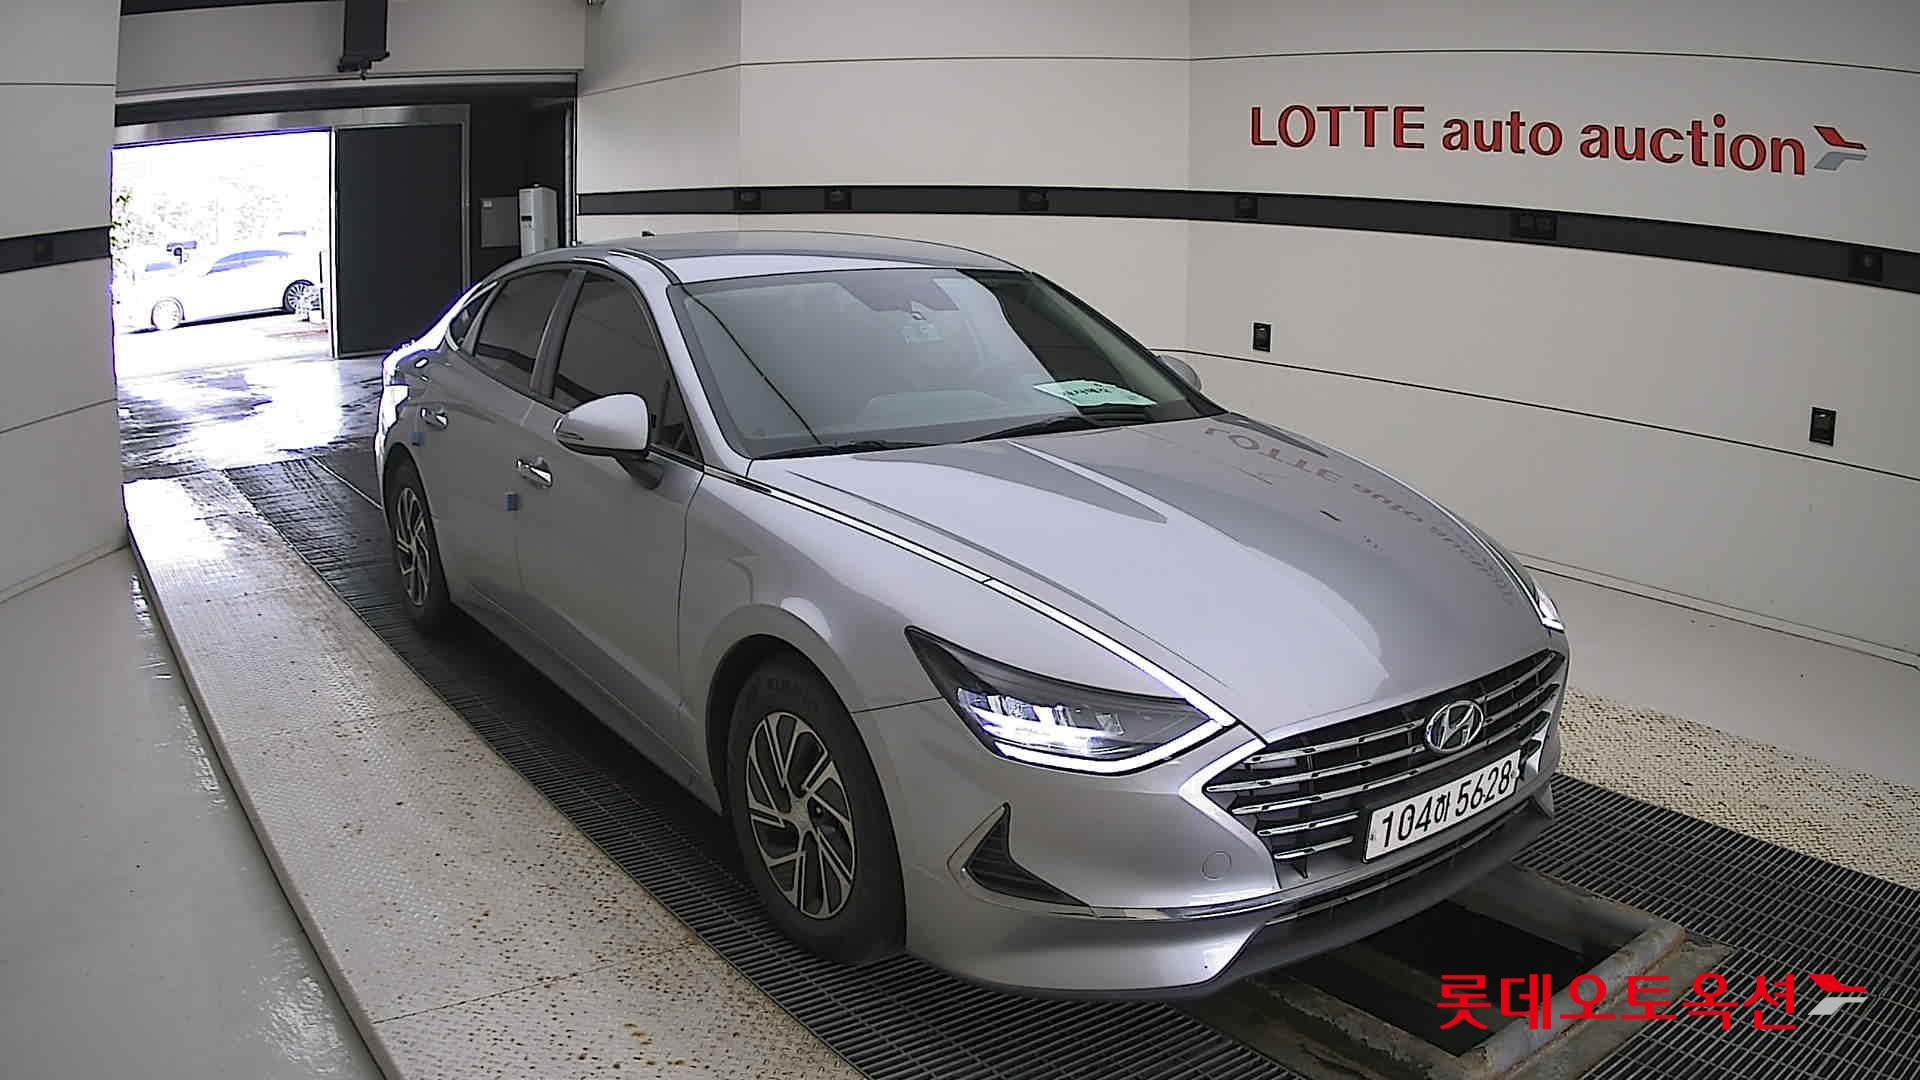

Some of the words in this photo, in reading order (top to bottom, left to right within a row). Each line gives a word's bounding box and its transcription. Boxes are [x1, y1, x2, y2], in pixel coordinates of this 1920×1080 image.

[1251, 106, 1425, 148] LOTTE
[1441, 111, 1563, 156] auto
[1580, 113, 1805, 175] auction
[1382, 791, 1451, 848] 104하
[1455, 760, 1512, 817] 5628
